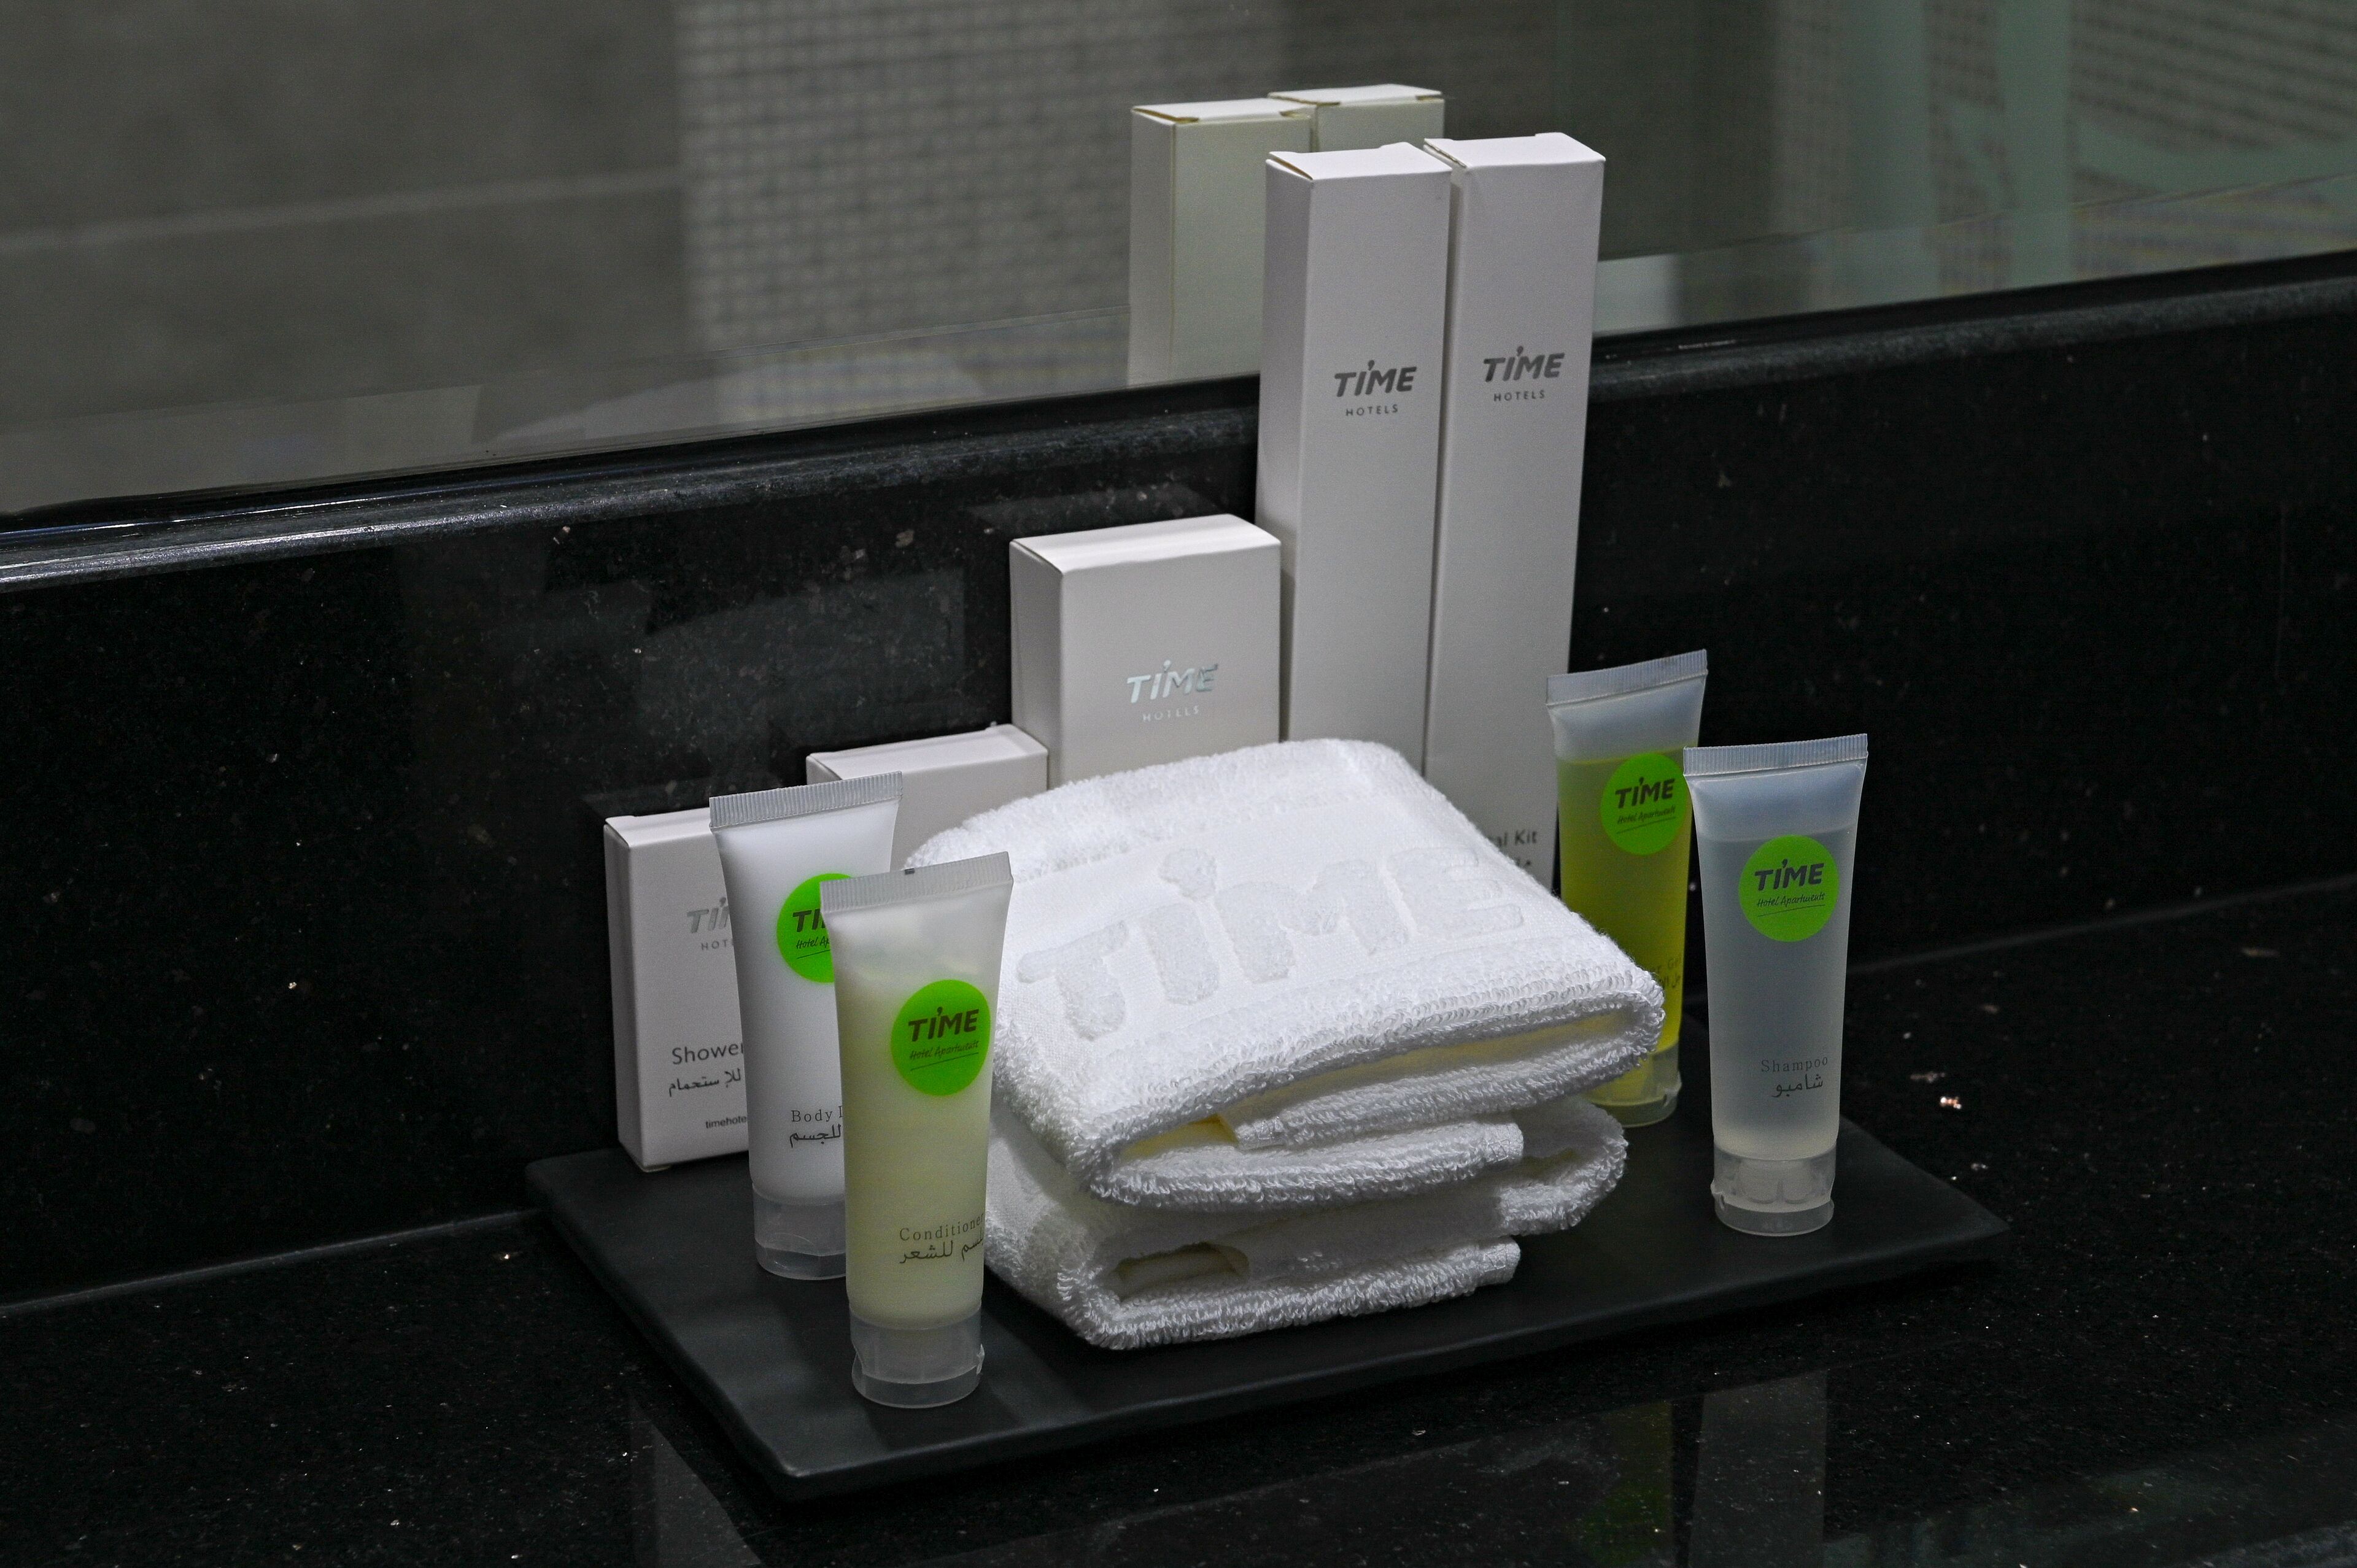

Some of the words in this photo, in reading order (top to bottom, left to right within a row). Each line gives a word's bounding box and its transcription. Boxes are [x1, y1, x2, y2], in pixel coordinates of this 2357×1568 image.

[1483, 346, 1565, 383] TIME
[1334, 360, 1417, 397] TIME
[1493, 389, 1546, 402] HOTELS
[1345, 403, 1399, 417] HOTELS
[1126, 660, 1218, 704] TIME
[1142, 705, 1200, 722] HOTELS
[1615, 776, 1676, 809] TIME
[1514, 829, 1538, 846] Kit
[1754, 858, 1825, 892] TIME
[1757, 896, 1779, 908] Hotel
[1781, 892, 1825, 908] Apartments
[795, 936, 819, 949] Hotel
[908, 1006, 980, 1042] TIME
[910, 1047, 933, 1060] Hotel
[1760, 1056, 1829, 1073] Shampoo
[1771, 1073, 1824, 1098] شامبو
[791, 1109, 833, 1122] Body
[789, 1122, 842, 1149] للجسم
[899, 1239, 954, 1264] للشعر
